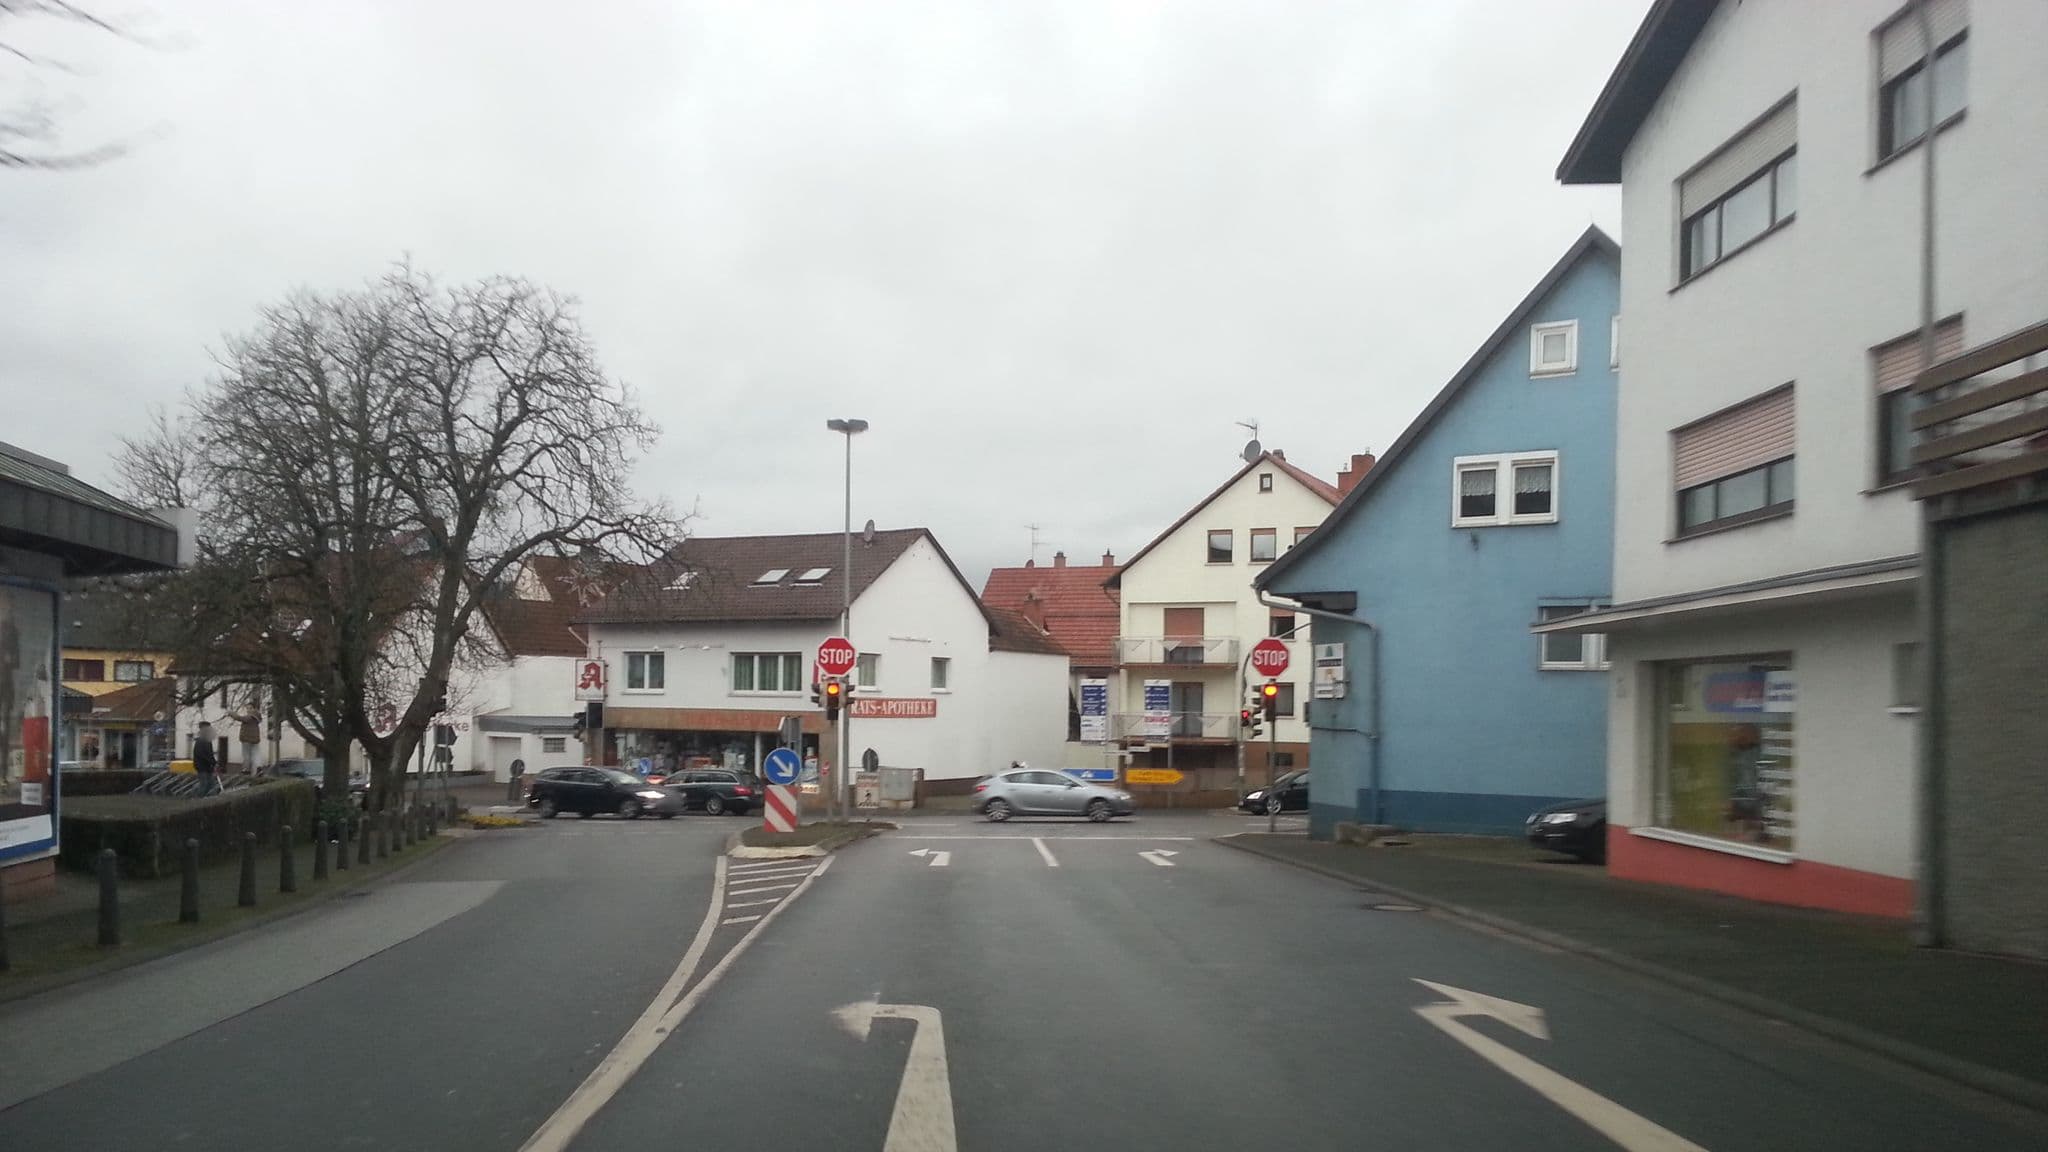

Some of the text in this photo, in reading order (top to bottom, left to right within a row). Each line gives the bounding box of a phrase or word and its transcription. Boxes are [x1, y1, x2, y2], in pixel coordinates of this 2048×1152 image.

[820, 648, 853, 664] STOP
[1254, 650, 1287, 666] STOP
[851, 700, 934, 714] RATS-APOTHEKE
